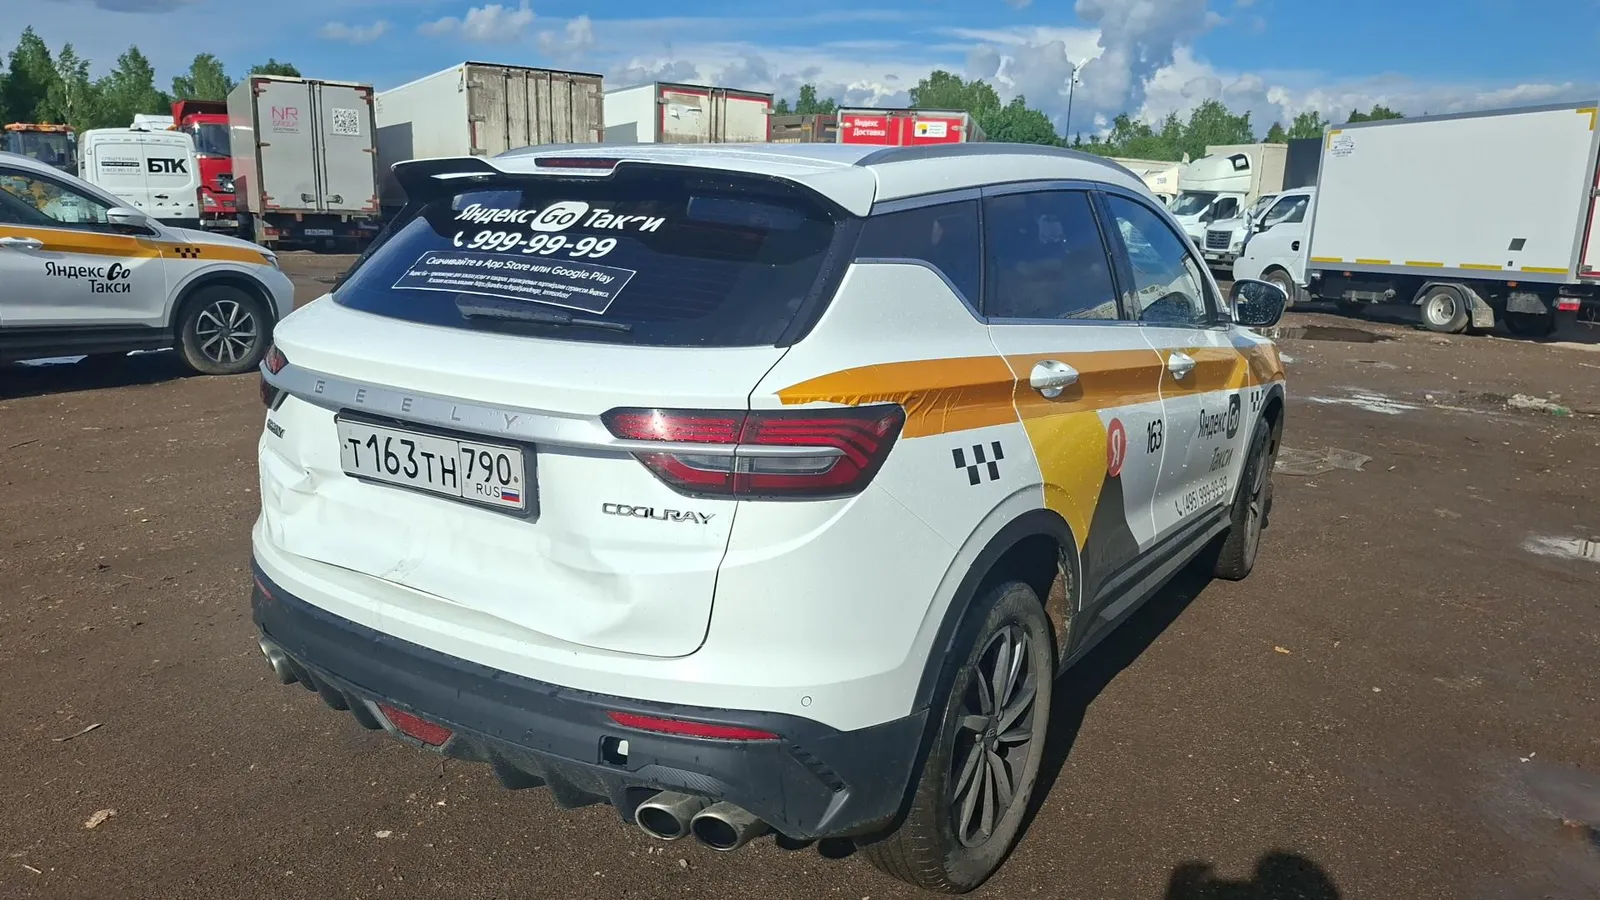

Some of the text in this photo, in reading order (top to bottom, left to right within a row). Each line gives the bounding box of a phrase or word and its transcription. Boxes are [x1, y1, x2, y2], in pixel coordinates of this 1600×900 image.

[271, 106, 298, 120] NR
[854, 119, 879, 128] Яндекс
[853, 128, 886, 136] Доставка
[147, 158, 188, 173] БТК
[454, 203, 537, 225] Яндекс
[540, 207, 577, 226] Go
[467, 230, 618, 258] 999-99-99
[45, 261, 131, 281] Яндекс Go
[426, 257, 475, 267] Скачивайте
[482, 259, 504, 270] App
[504, 260, 531, 271] Store
[530, 265, 551, 274] или
[552, 266, 590, 279] Google
[589, 271, 615, 284] Play
[88, 279, 131, 293] Такси
[314, 380, 519, 430] GEELY
[1198, 403, 1240, 441] Яндекс Go
[1146, 418, 1163, 454] 163
[1111, 428, 1121, 468] Я
[461, 447, 512, 486] 790
[1208, 446, 1234, 474] Такси
[476, 483, 501, 498] RUS
[601, 502, 716, 525] COOLRAY
